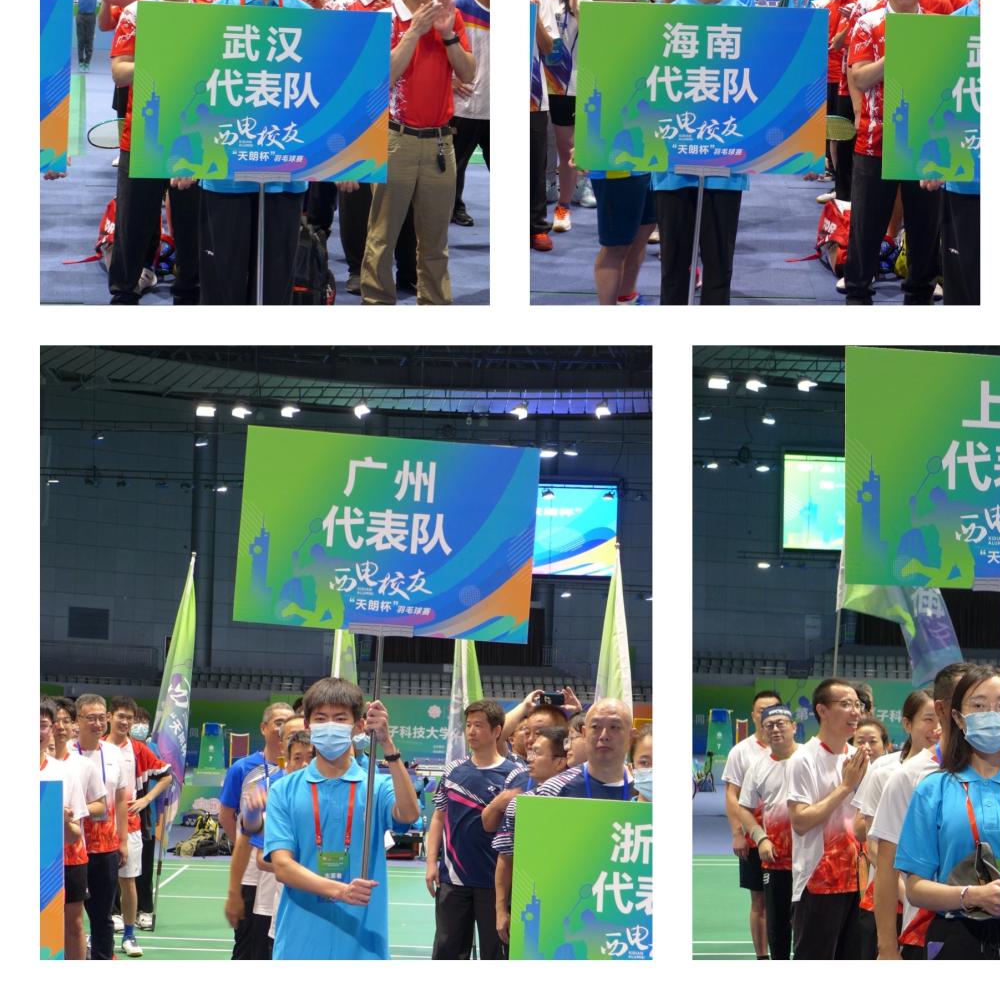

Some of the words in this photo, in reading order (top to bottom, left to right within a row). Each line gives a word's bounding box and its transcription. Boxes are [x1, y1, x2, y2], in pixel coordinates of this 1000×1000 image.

[222, 24, 303, 63] 武汉
[662, 22, 743, 59] 海南
[206, 68, 320, 109] 代表队
[646, 65, 759, 104] 代表队
[214, 116, 305, 150] 西电校友
[654, 111, 744, 144] 西电校友
[343, 456, 437, 504] 广州
[322, 505, 453, 556] 代表队
[329, 560, 433, 600] 西电校友
[388, 725, 449, 740] 子科技大学
[610, 822, 653, 864] 浙
[600, 924, 653, 957] 西电
